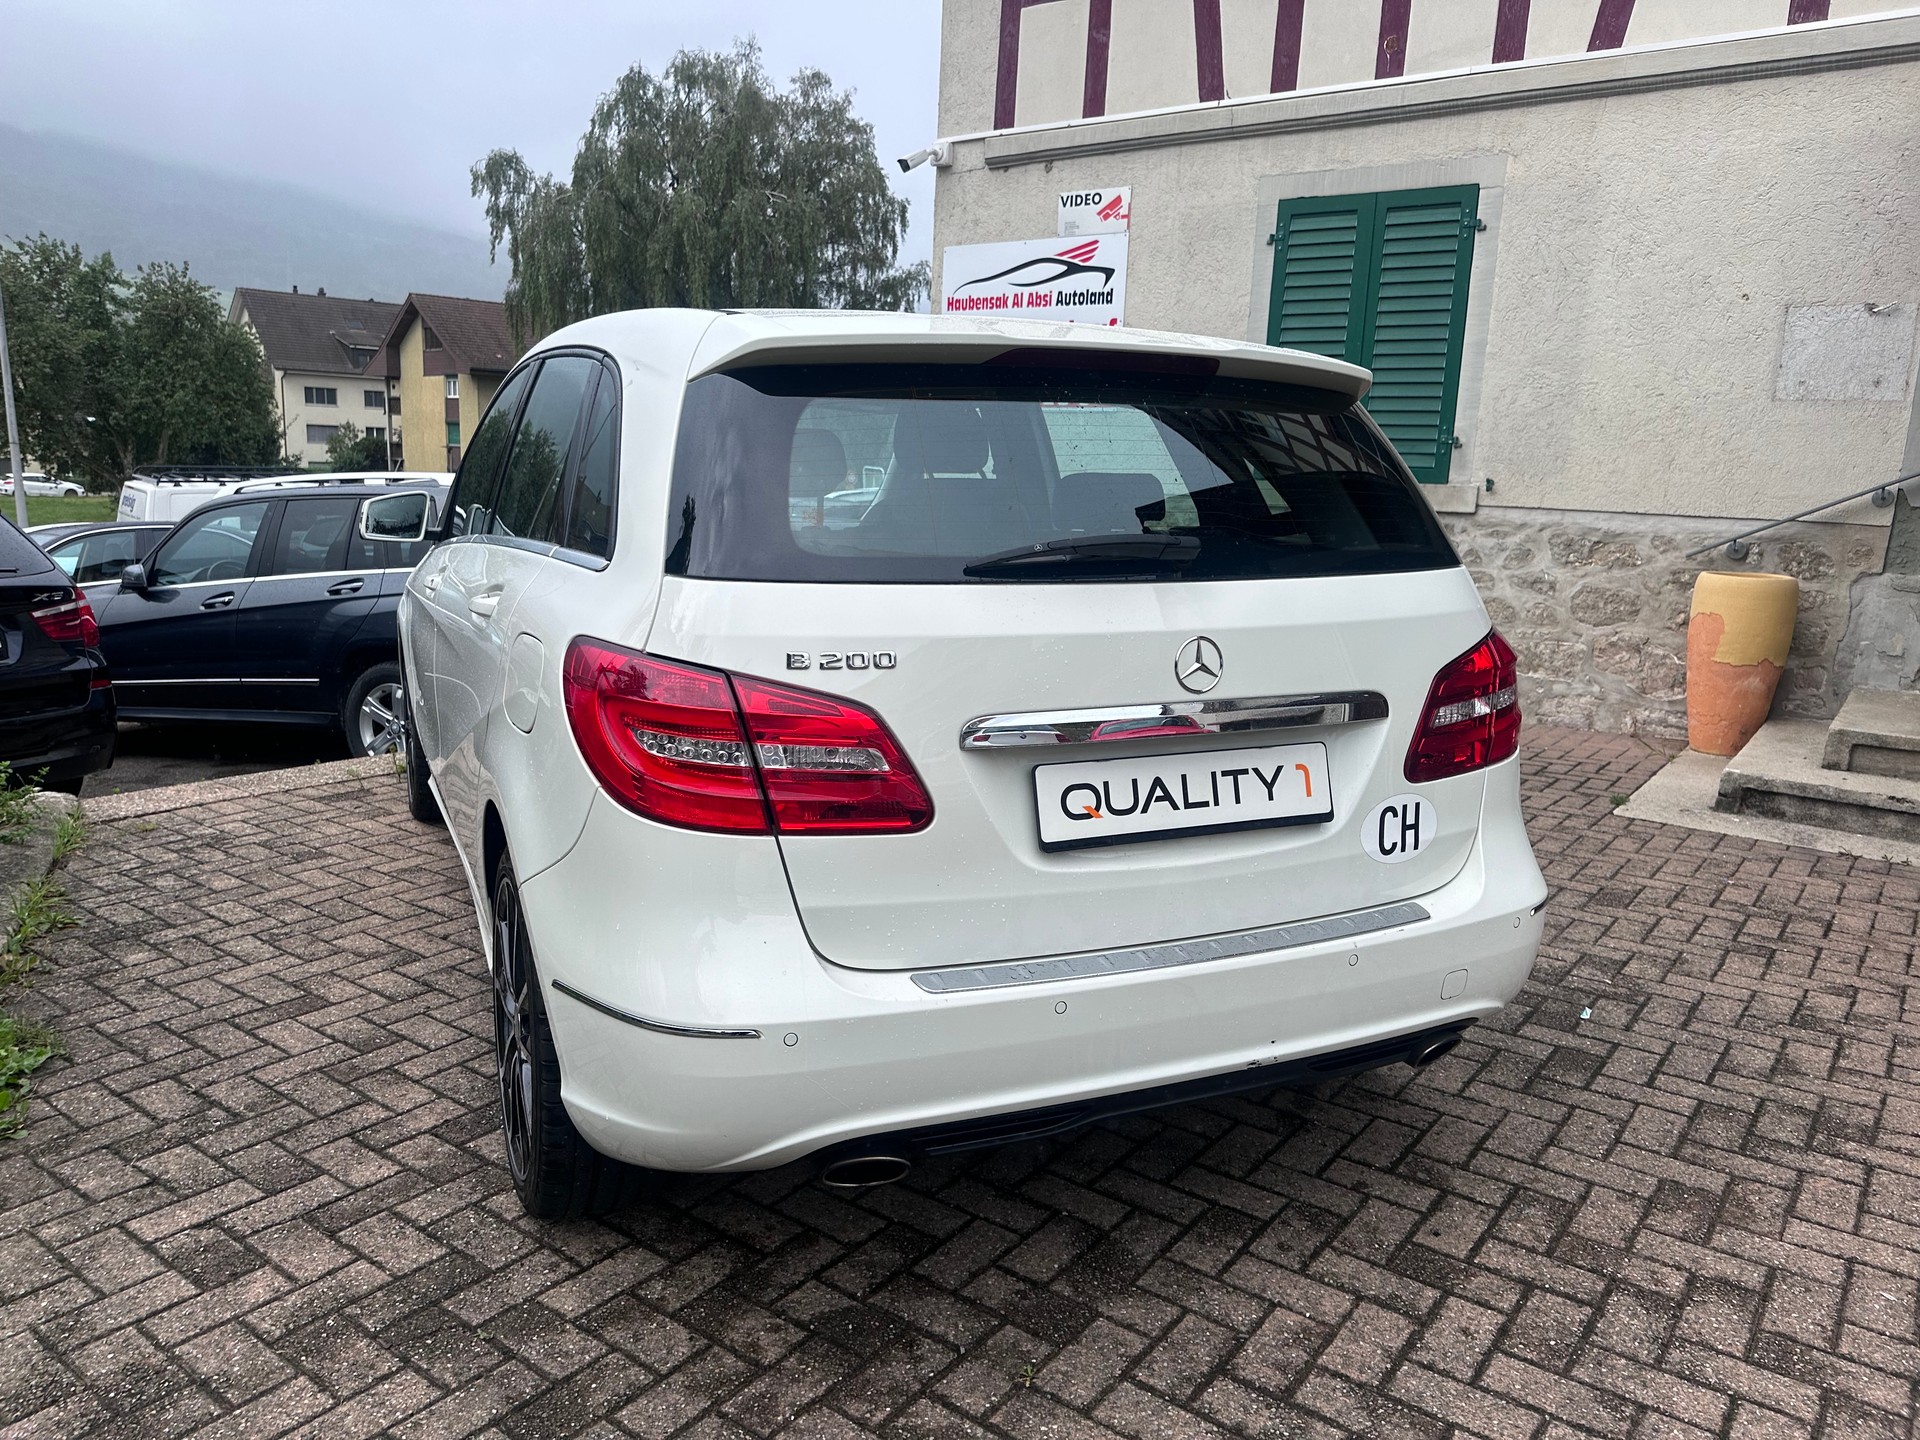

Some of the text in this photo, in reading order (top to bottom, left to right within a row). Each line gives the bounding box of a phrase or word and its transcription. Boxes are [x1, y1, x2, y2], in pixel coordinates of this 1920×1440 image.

[1060, 192, 1102, 208] VIDEO
[947, 294, 1009, 312] Haubensak
[1026, 291, 1053, 308] Absi
[1055, 288, 1114, 307] Autoland
[786, 650, 897, 670] B 200
[1060, 765, 1284, 821] QUALITY
[1378, 801, 1420, 856] CH
